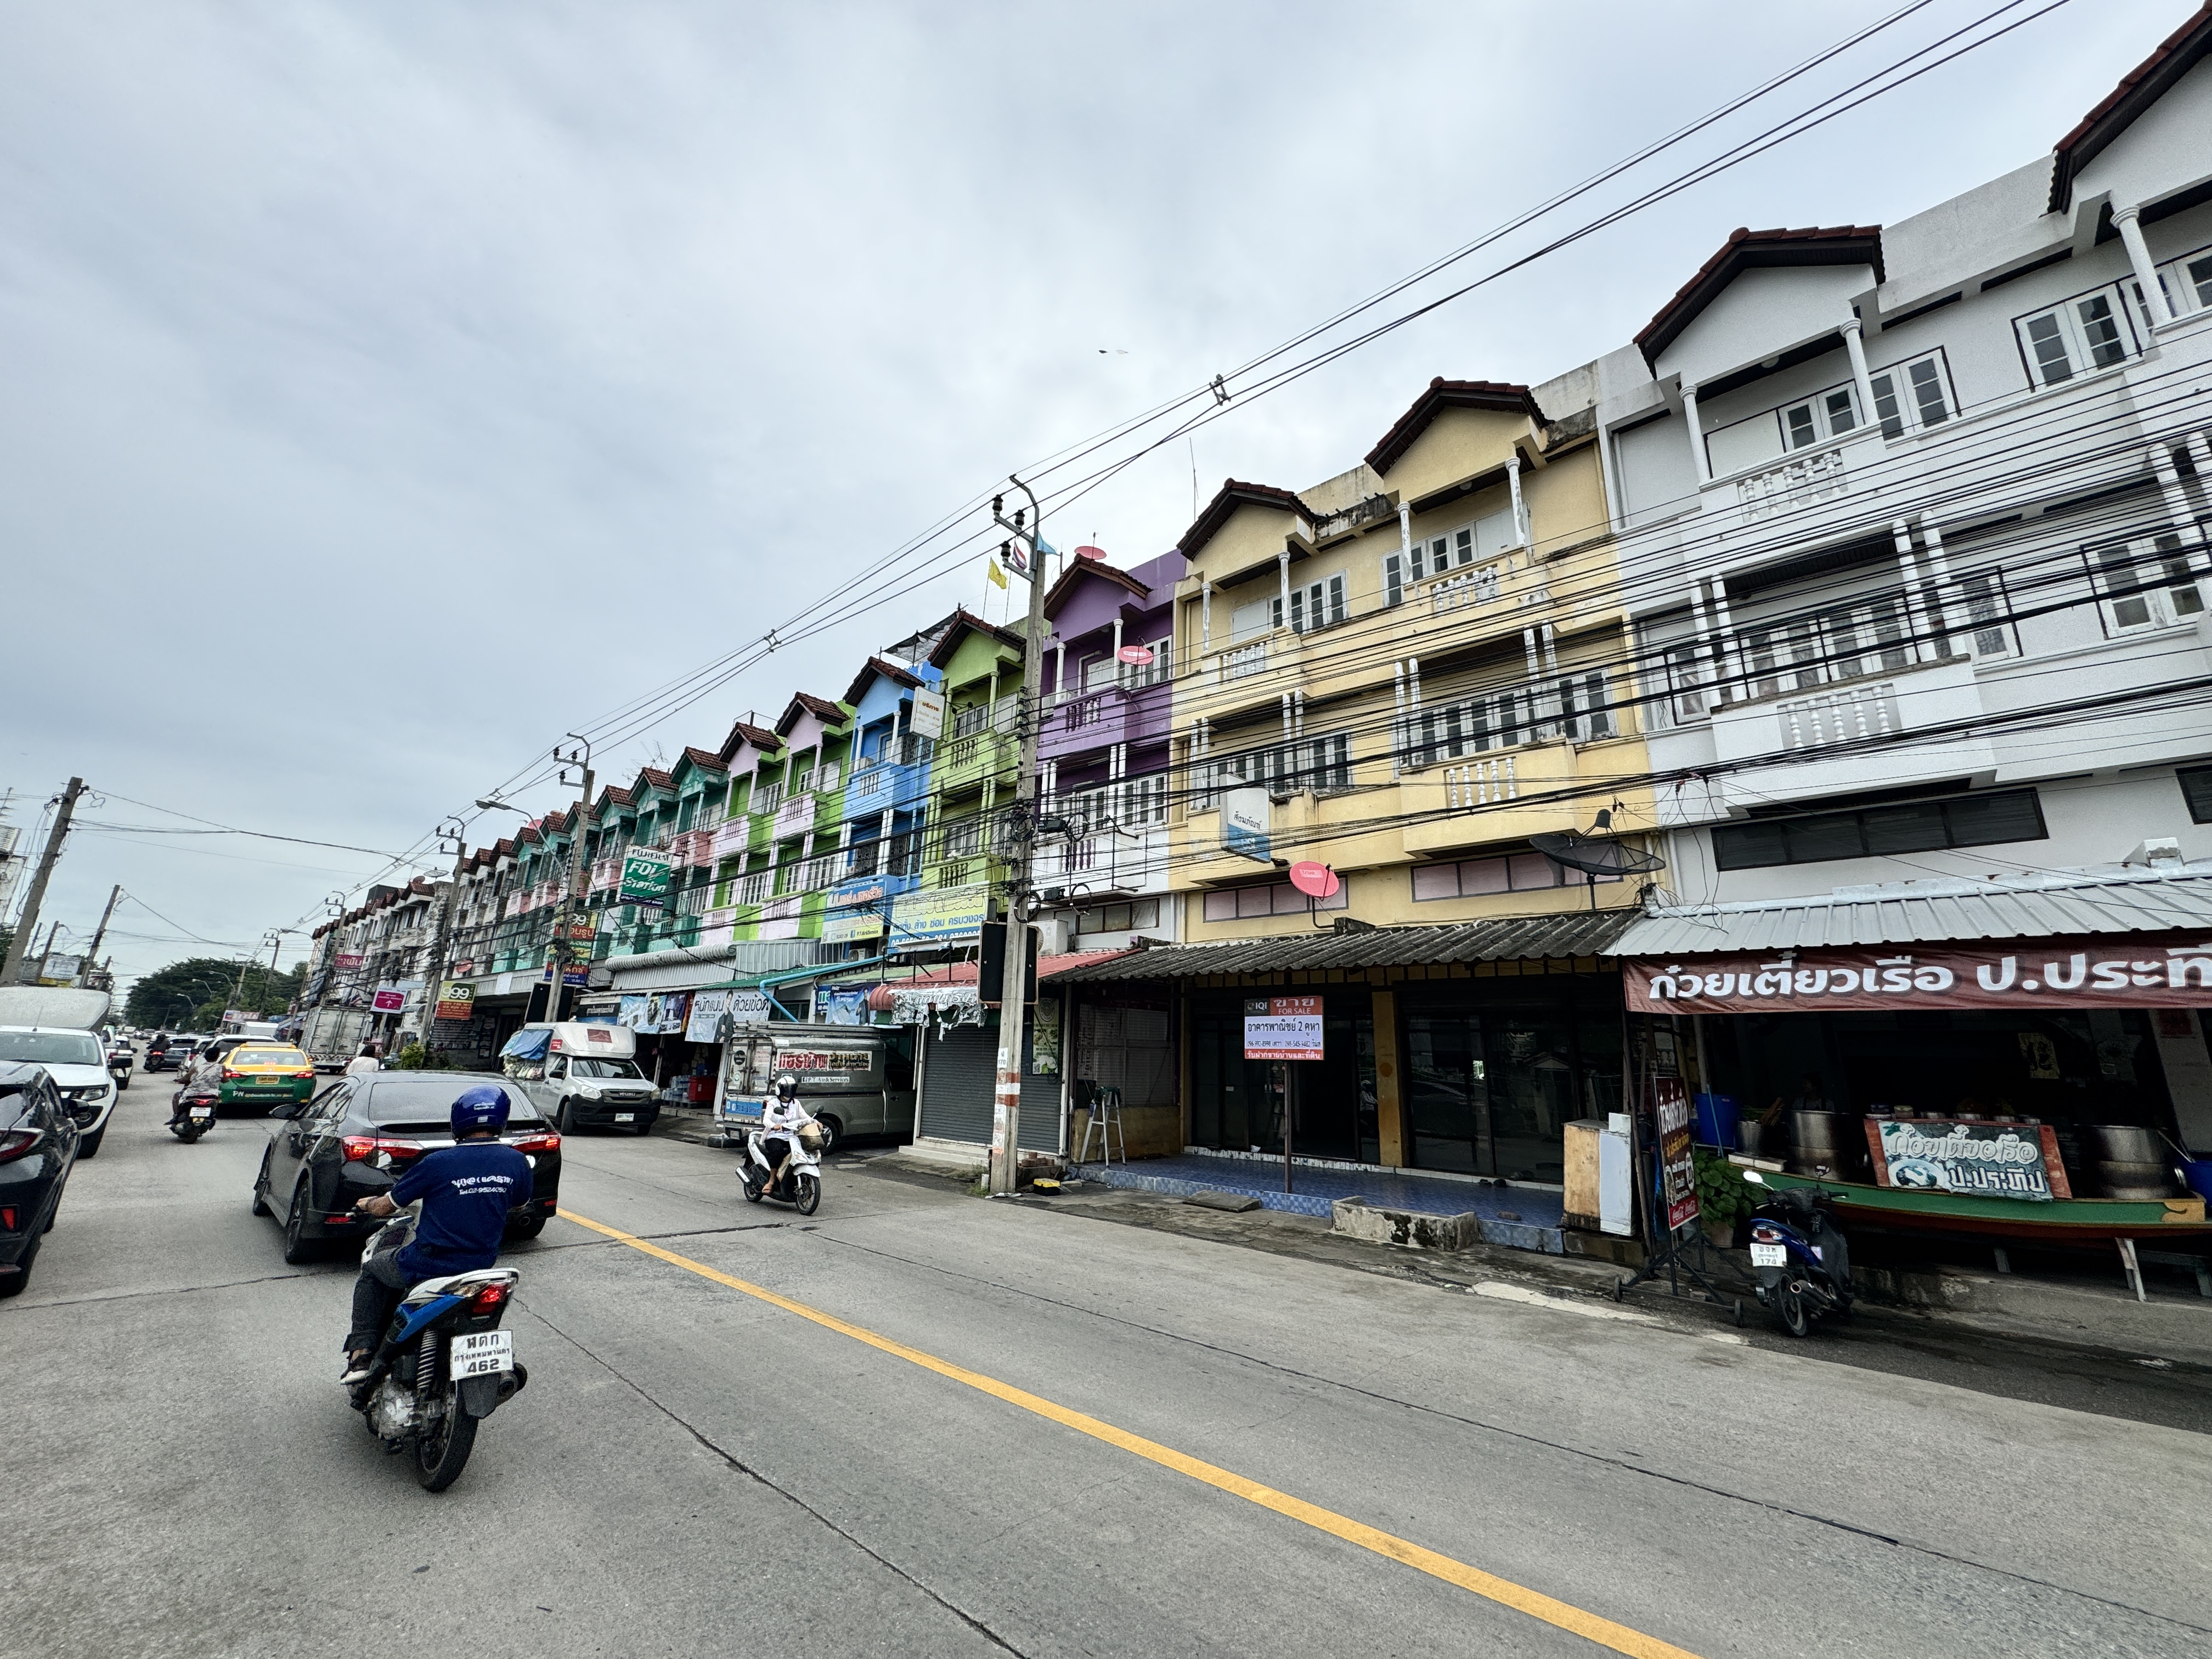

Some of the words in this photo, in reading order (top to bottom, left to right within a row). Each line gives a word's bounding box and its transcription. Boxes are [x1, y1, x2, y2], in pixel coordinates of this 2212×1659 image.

[632, 849, 669, 862] FUJIFILM
[623, 876, 667, 893] Station
[914, 919, 927, 929] ล้าง
[930, 917, 945, 928] ซ่อม
[948, 913, 984, 925] ครบวงจร
[1649, 950, 1953, 999] ก๋วยเตี๋ยวเรือ
[441, 986, 470, 1000] 999
[1255, 1001, 1268, 1011] IQI
[1273, 998, 1314, 1007] ขาย
[1248, 1017, 1296, 1032] อาคารพาณิชย์
[1298, 1021, 1303, 1031] 2
[1305, 1022, 1321, 1036] คูหา
[778, 1051, 828, 1070] แอร์บ้าน
[1246, 1049, 1321, 1059] รับฝากขายบ้านและที่ดิน
[1886, 1123, 2038, 1165] ก๋วยเตี๋ยวเรือ
[1949, 1165, 2047, 1193] ป.ประทีป
[454, 1348, 510, 1362] กรุงเทพมหานคร
[467, 1358, 500, 1373] 462
